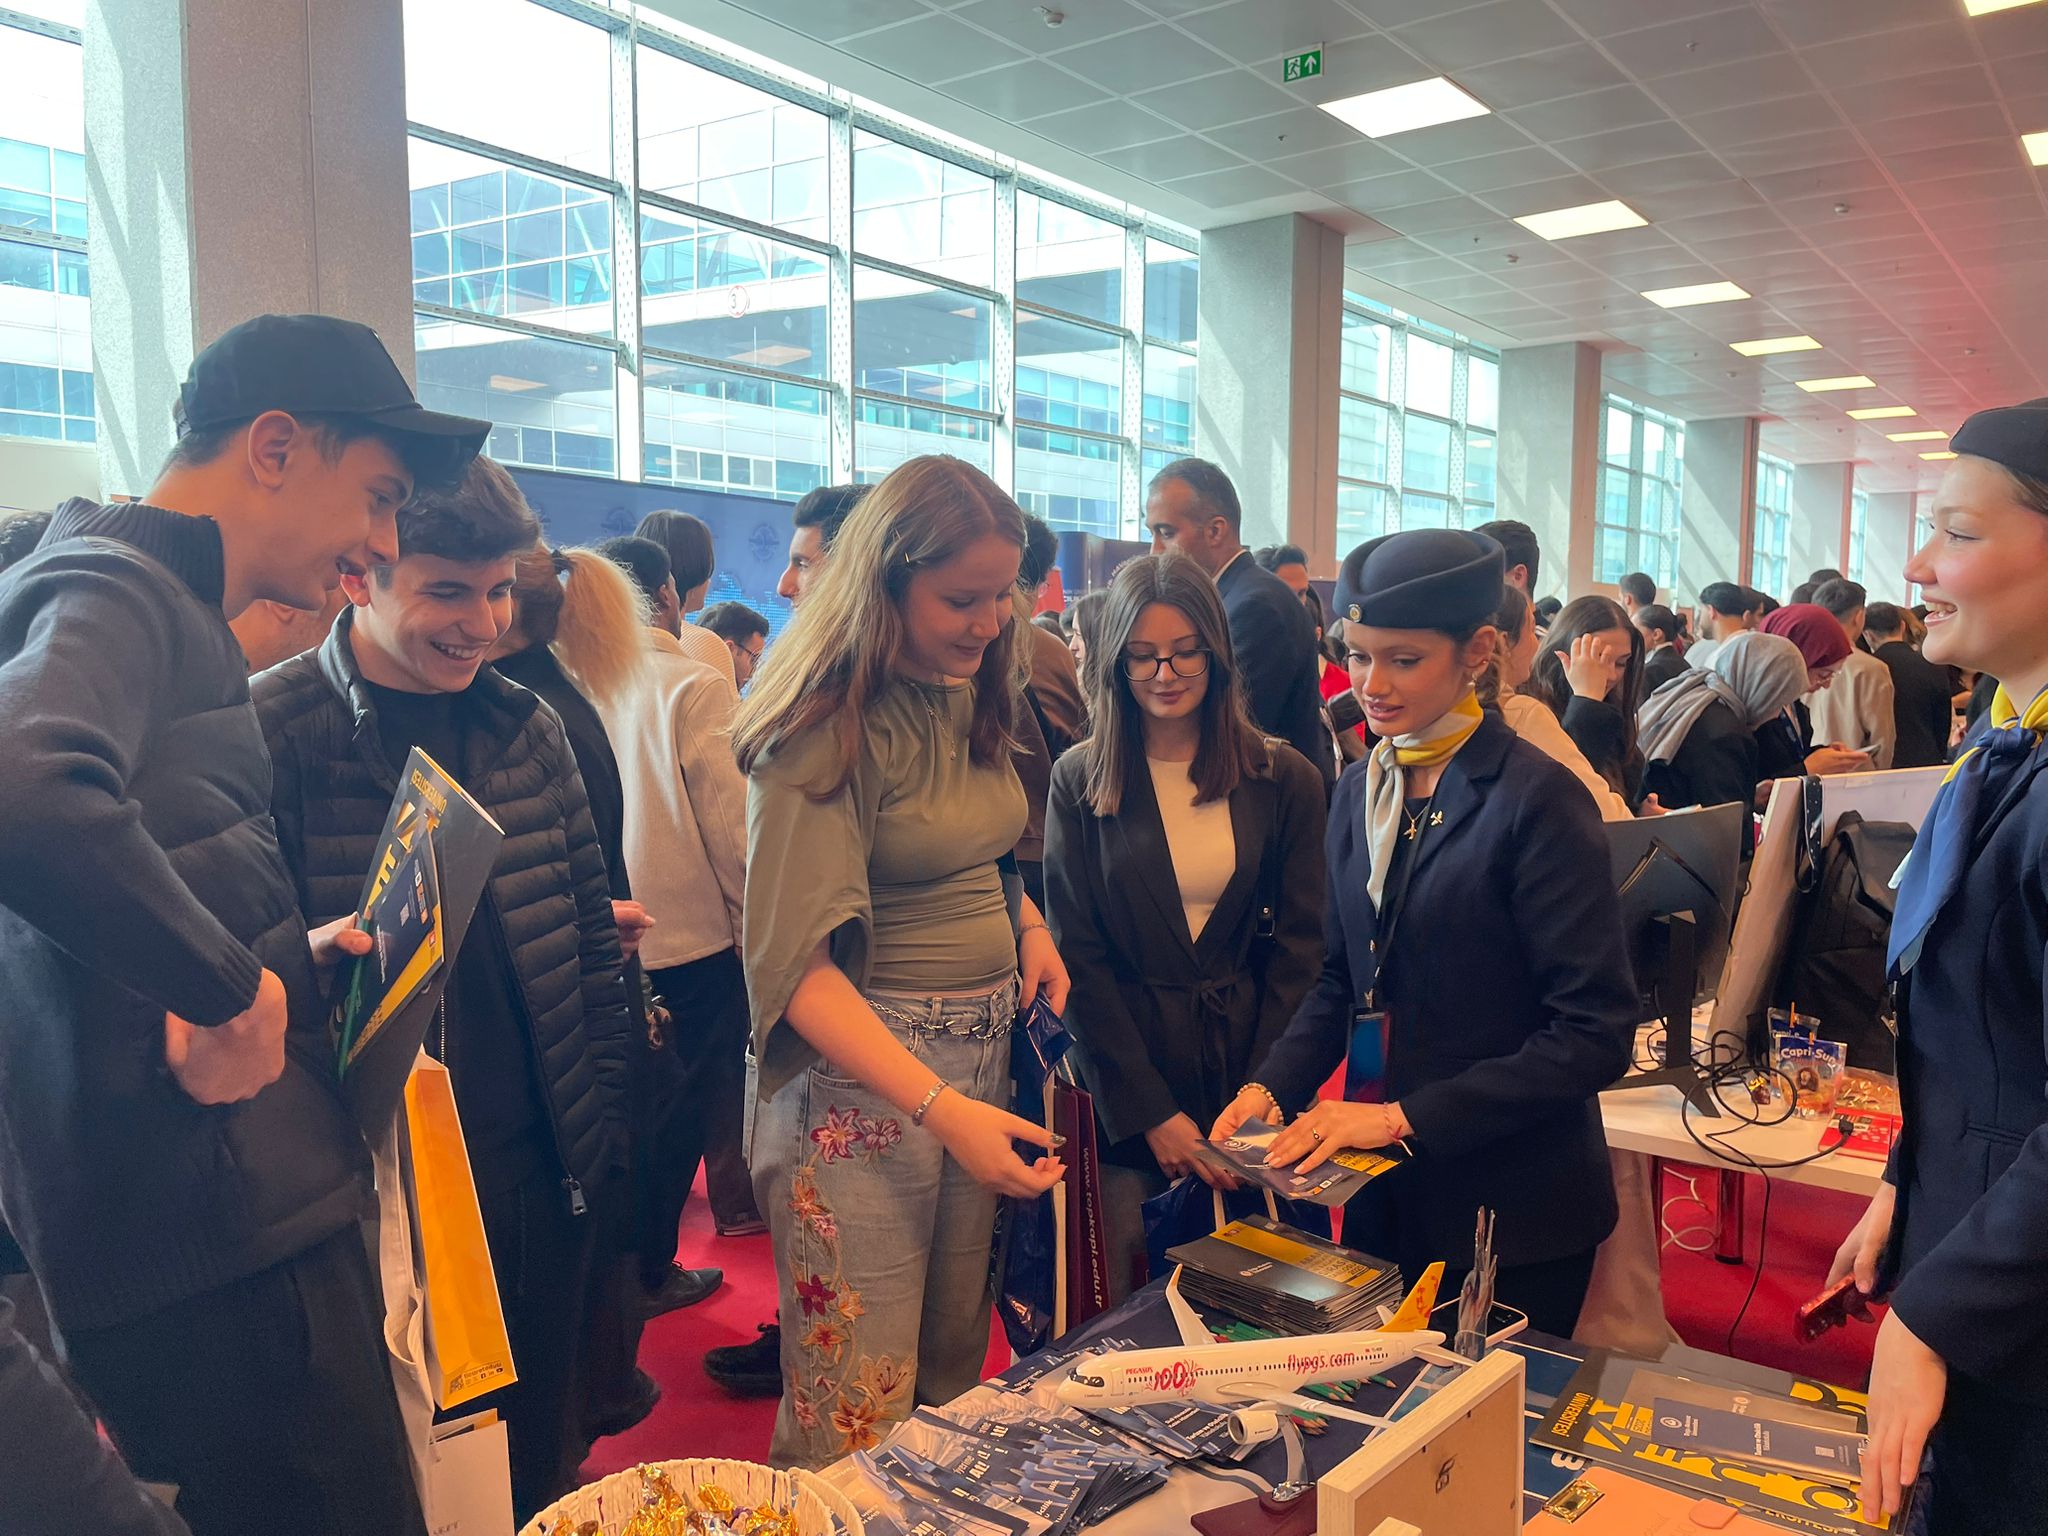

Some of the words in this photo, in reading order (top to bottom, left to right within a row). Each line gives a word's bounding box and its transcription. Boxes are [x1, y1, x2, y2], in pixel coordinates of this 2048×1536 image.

[1082, 1147, 1103, 1309] www.topkapi.edu.tr
[1126, 1366, 1153, 1375] PEGASUS
[1288, 1352, 1355, 1375] flypgs.com
[1551, 1392, 1591, 1438] ÜNİVERSİTESİ
